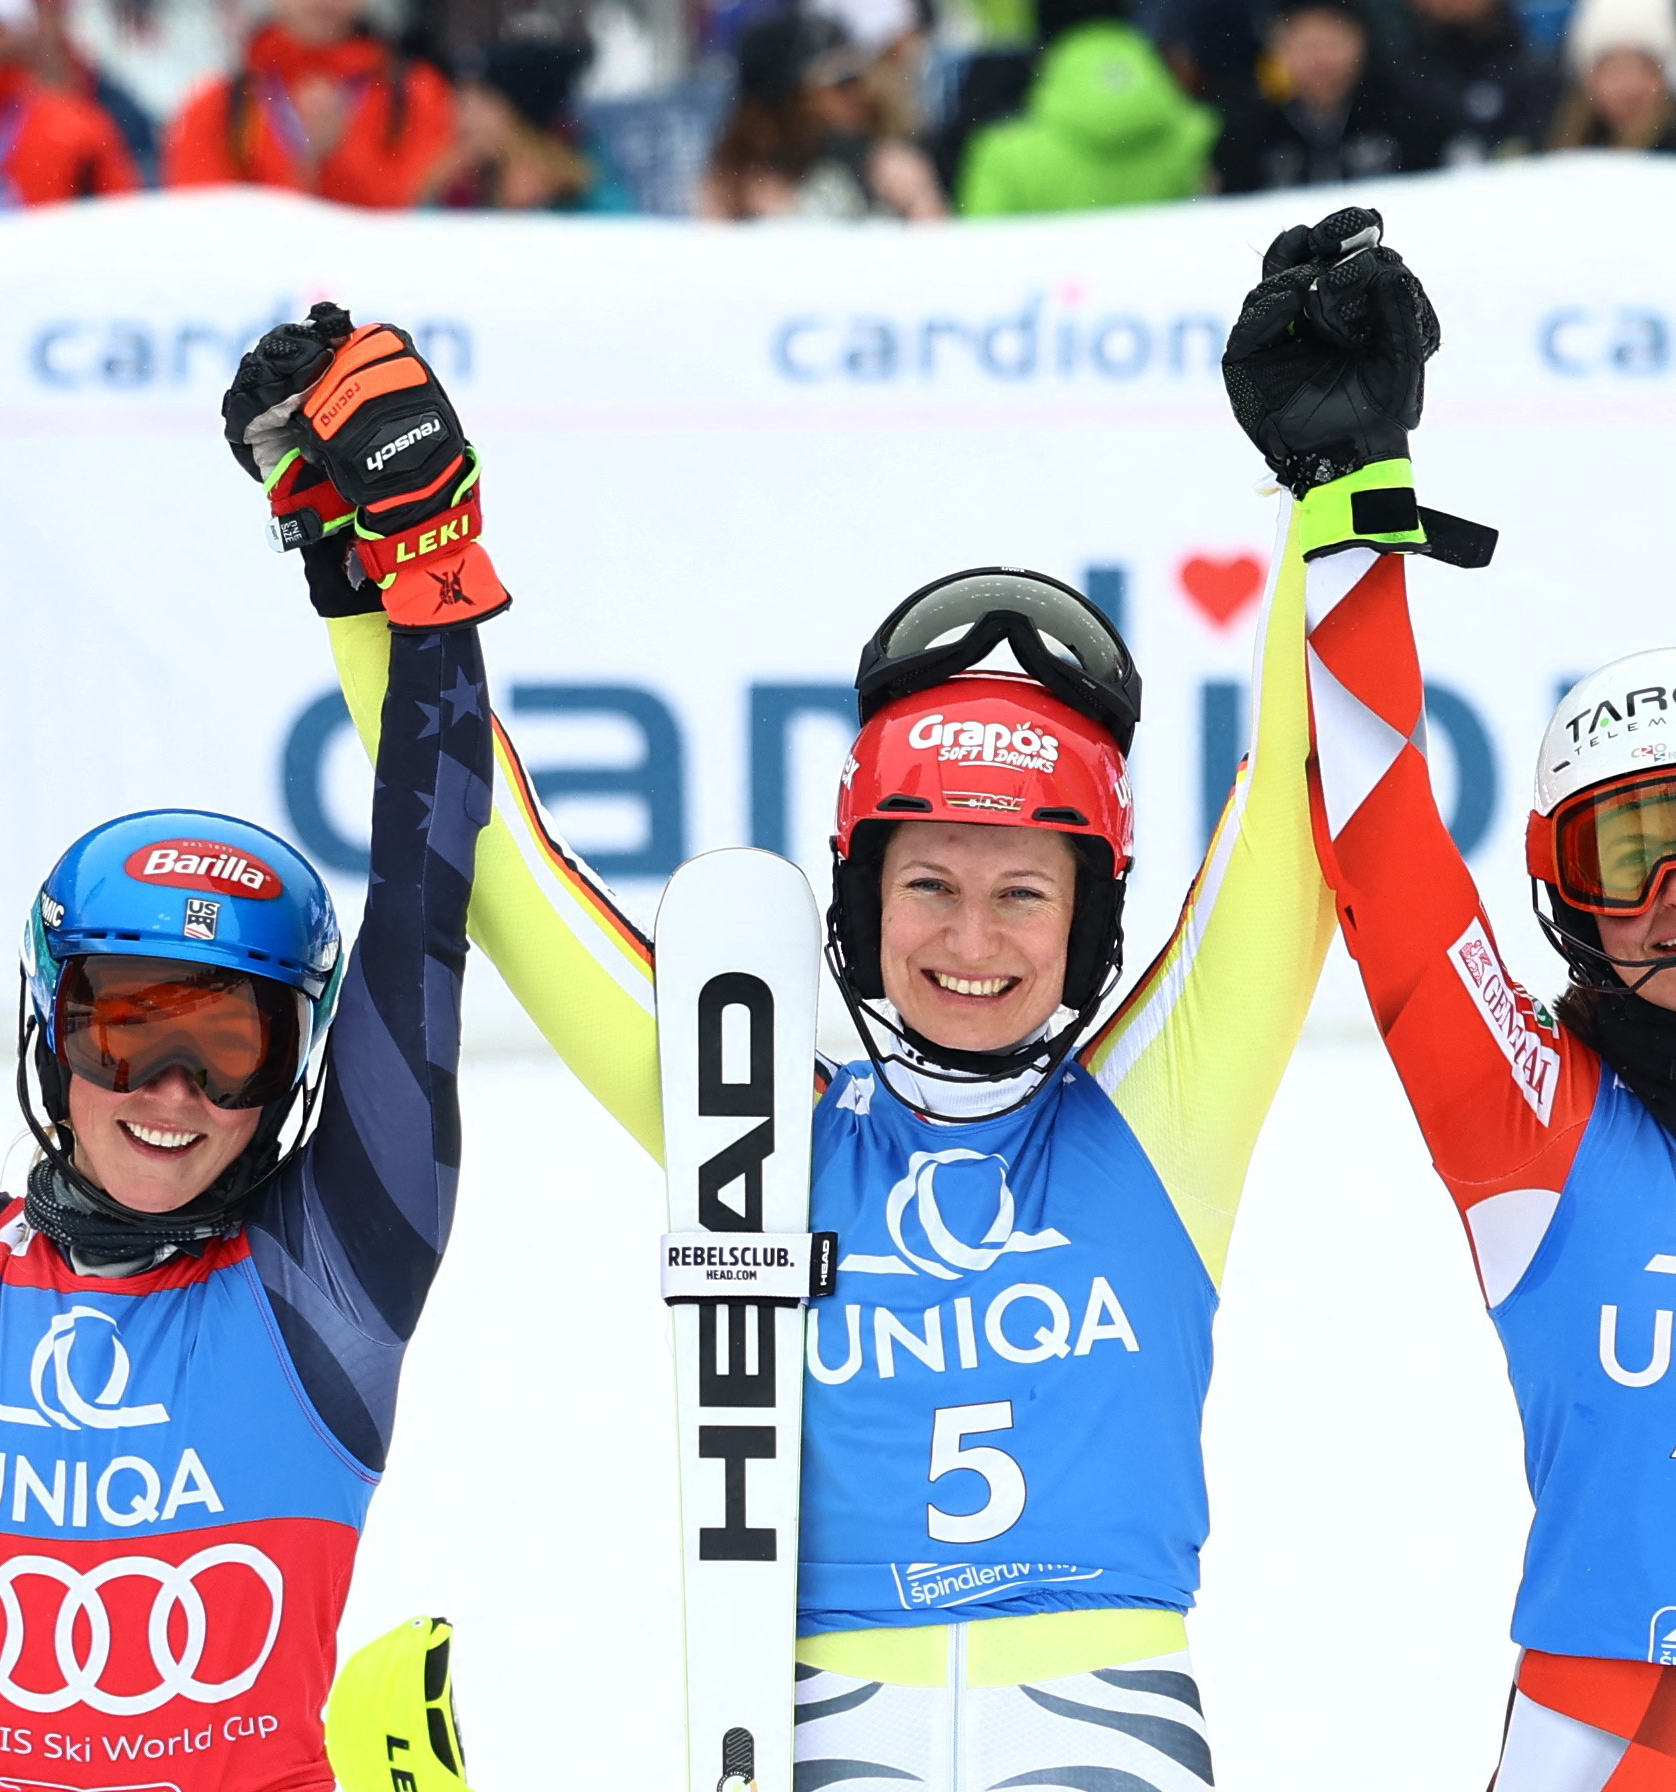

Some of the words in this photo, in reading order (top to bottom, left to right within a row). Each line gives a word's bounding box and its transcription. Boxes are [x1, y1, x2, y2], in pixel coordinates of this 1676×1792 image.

[767, 280, 1233, 384] cardion
[320, 381, 363, 428] racing
[365, 418, 442, 473] reusch
[280, 522, 295, 544] SIZE
[288, 519, 303, 541] ONE
[395, 513, 472, 564] LEKI
[937, 745, 985, 763] SOFT
[994, 748, 1055, 774] DRINKS
[142, 847, 268, 891] Barilla
[188, 898, 219, 918] US
[666, 1244, 796, 1269] REBELSCLUB.
[697, 971, 778, 1562] HEAD
[705, 1268, 759, 1282] HEAD.COM
[818, 1238, 832, 1287] HEAD
[807, 1275, 1141, 1386] UNIQA
[926, 1399, 1027, 1545] 5
[42, 1731, 92, 1763] Ski
[102, 1723, 213, 1762] World
[222, 1713, 280, 1745] Cup
